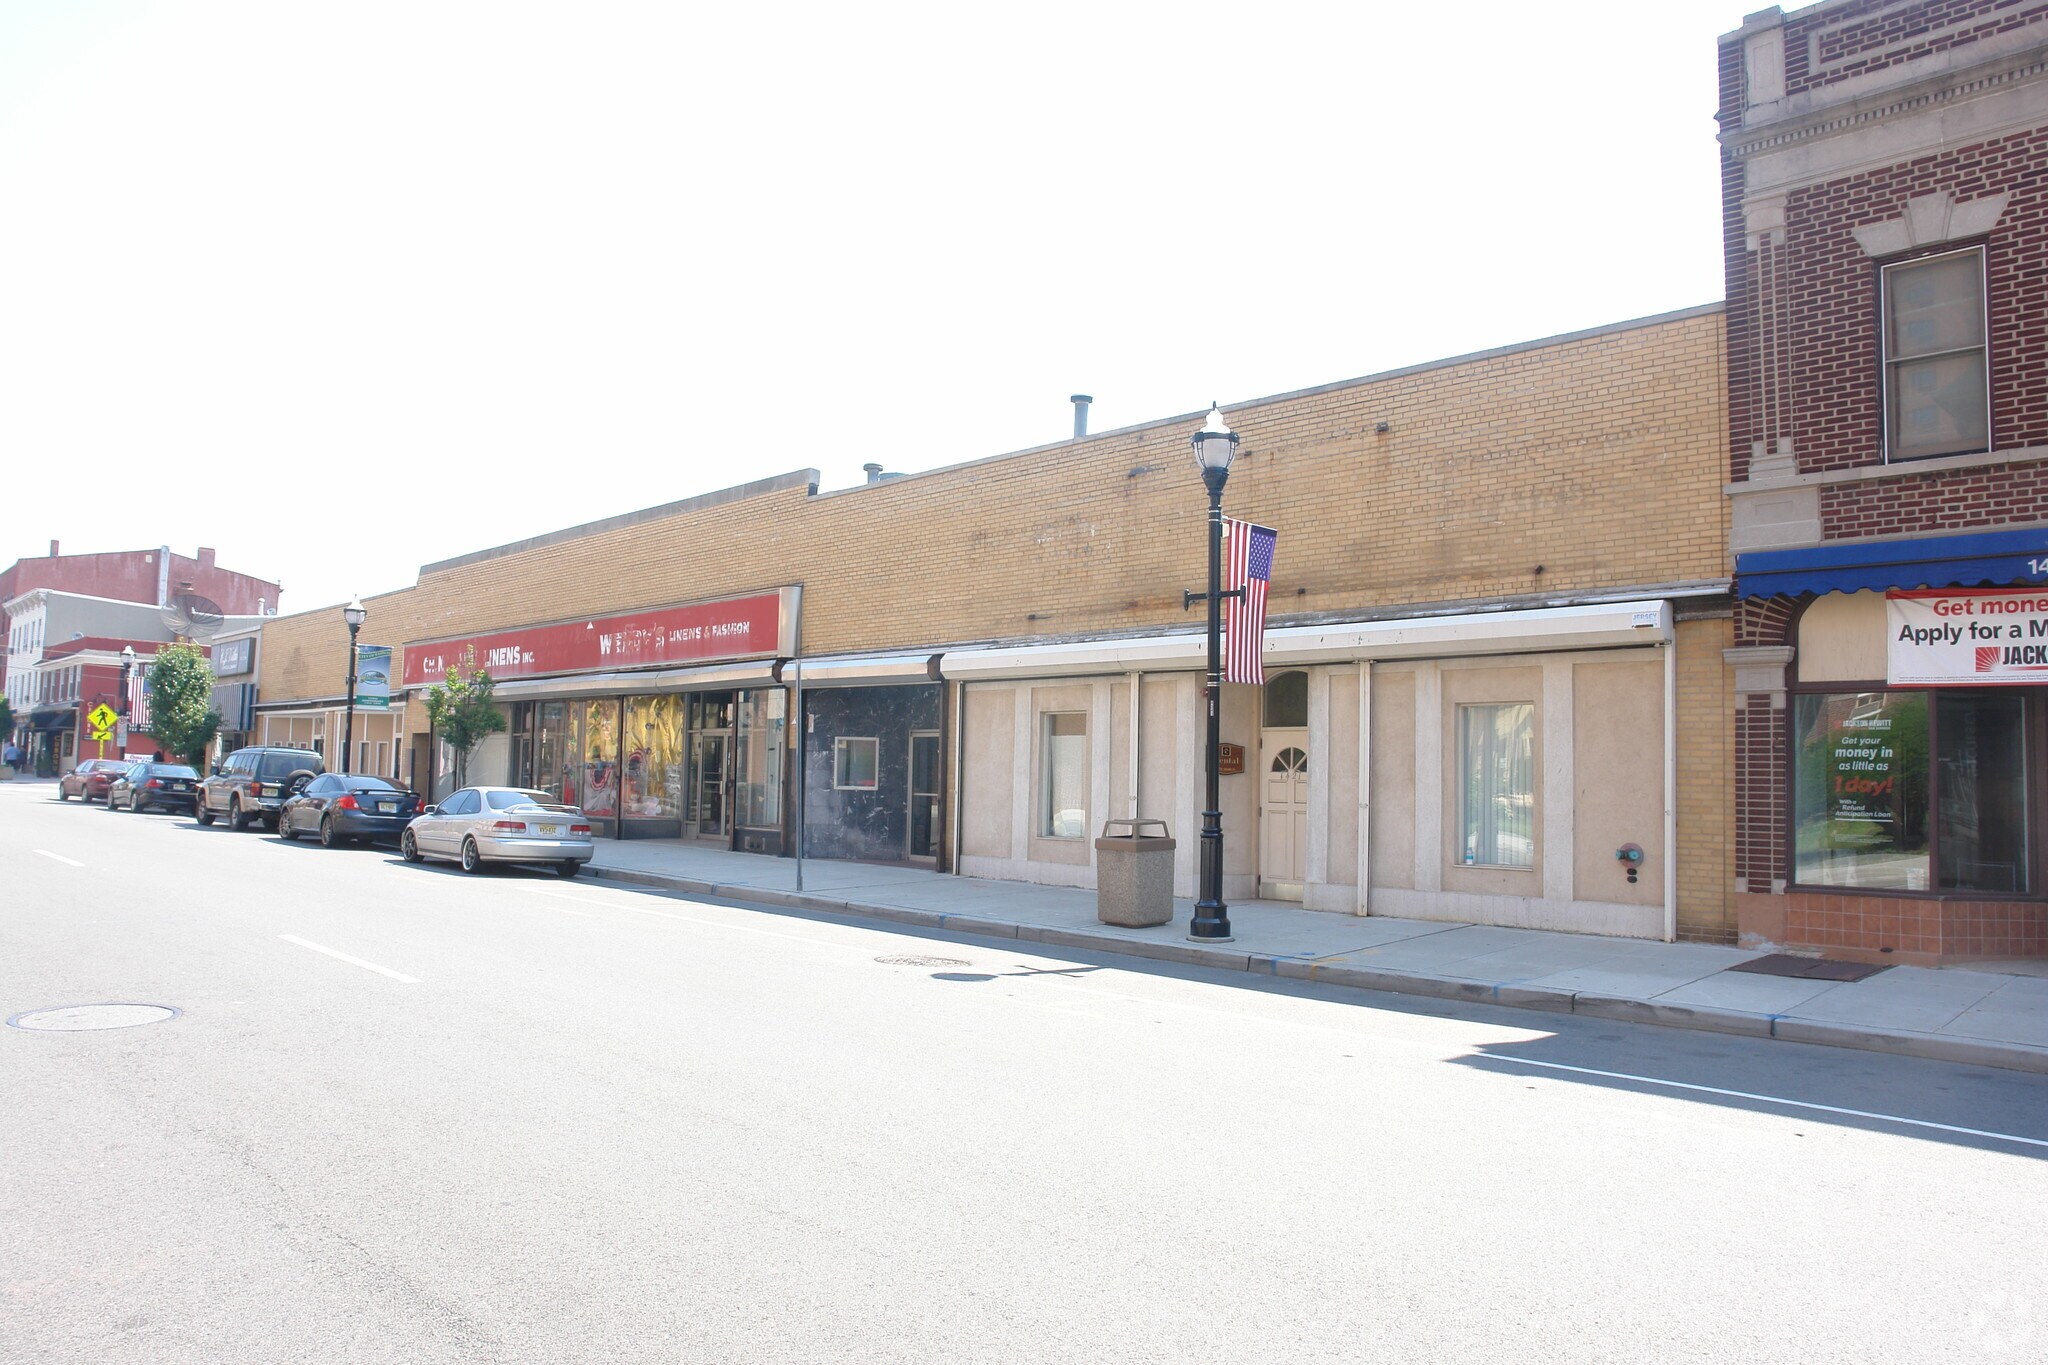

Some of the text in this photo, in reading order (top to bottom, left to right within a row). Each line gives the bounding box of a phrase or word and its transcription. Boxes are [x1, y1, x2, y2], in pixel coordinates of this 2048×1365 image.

[1933, 599, 1974, 616] Get
[712, 621, 750, 635] FASHION
[1898, 622, 1963, 645] Apply
[1968, 621, 2002, 639] for
[2009, 624, 2022, 638] a
[522, 652, 535, 663] INC.
[1841, 736, 1881, 746] Get your
[1835, 746, 1893, 760] money in
[1219, 757, 1239, 765] ental
[1852, 761, 1875, 770] little
[1876, 763, 1889, 771] as
[1835, 775, 1894, 797] 1 day!
[1835, 810, 1873, 818] Anticipation
